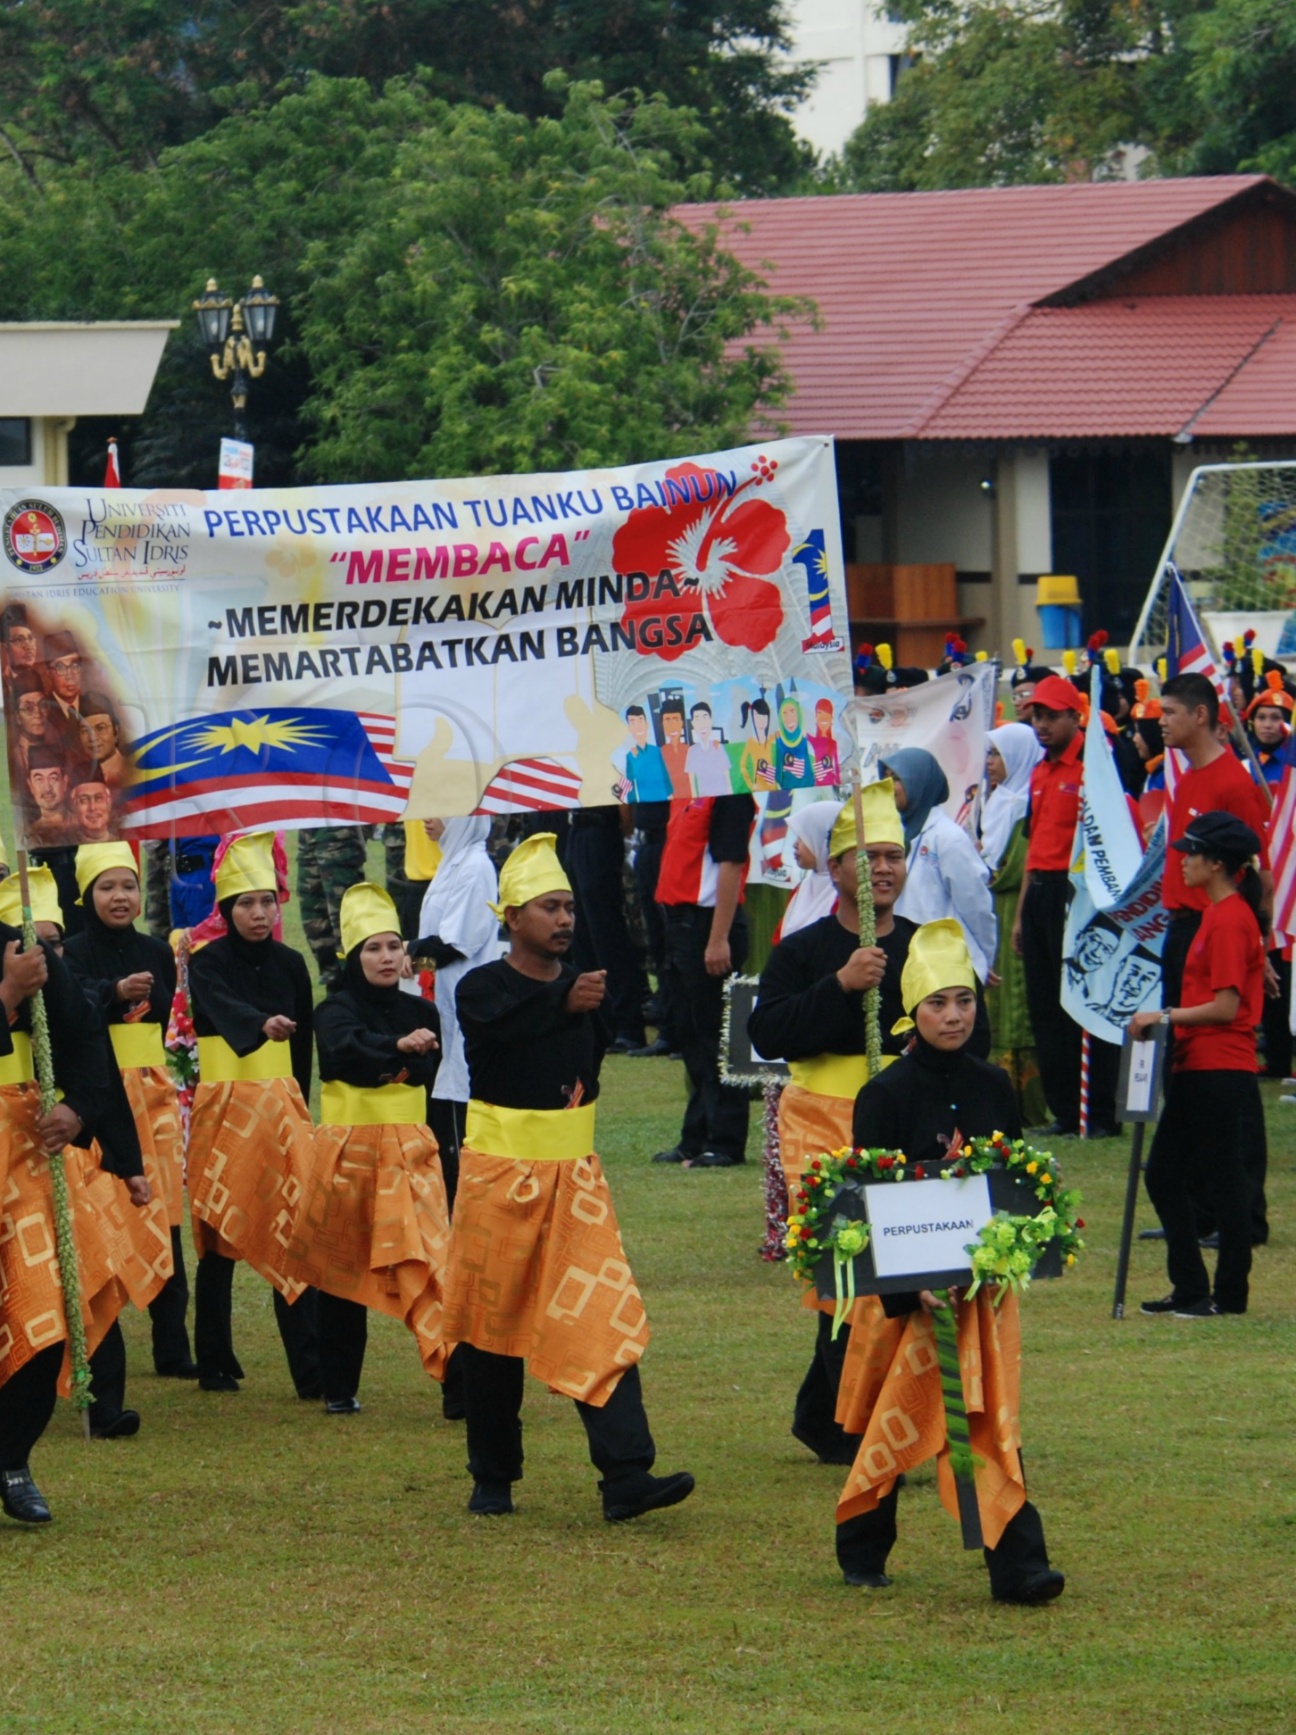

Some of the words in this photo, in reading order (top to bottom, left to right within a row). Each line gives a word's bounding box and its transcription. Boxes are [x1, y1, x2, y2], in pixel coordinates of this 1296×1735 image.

[85, 498, 187, 523] UNIVERSITI
[204, 502, 459, 537] PERPUSTAKAAN
[464, 487, 604, 527] TUANKU
[616, 469, 737, 511] BAINUN
[81, 519, 191, 545] PENDIDIKAN
[73, 538, 137, 567] SULTAN
[143, 540, 189, 565] IDRIS
[207, 629, 546, 687] MEMARTABATKAN
[556, 613, 714, 657] BANGSA
[883, 1219, 974, 1237] PERPUSTAKAAN
